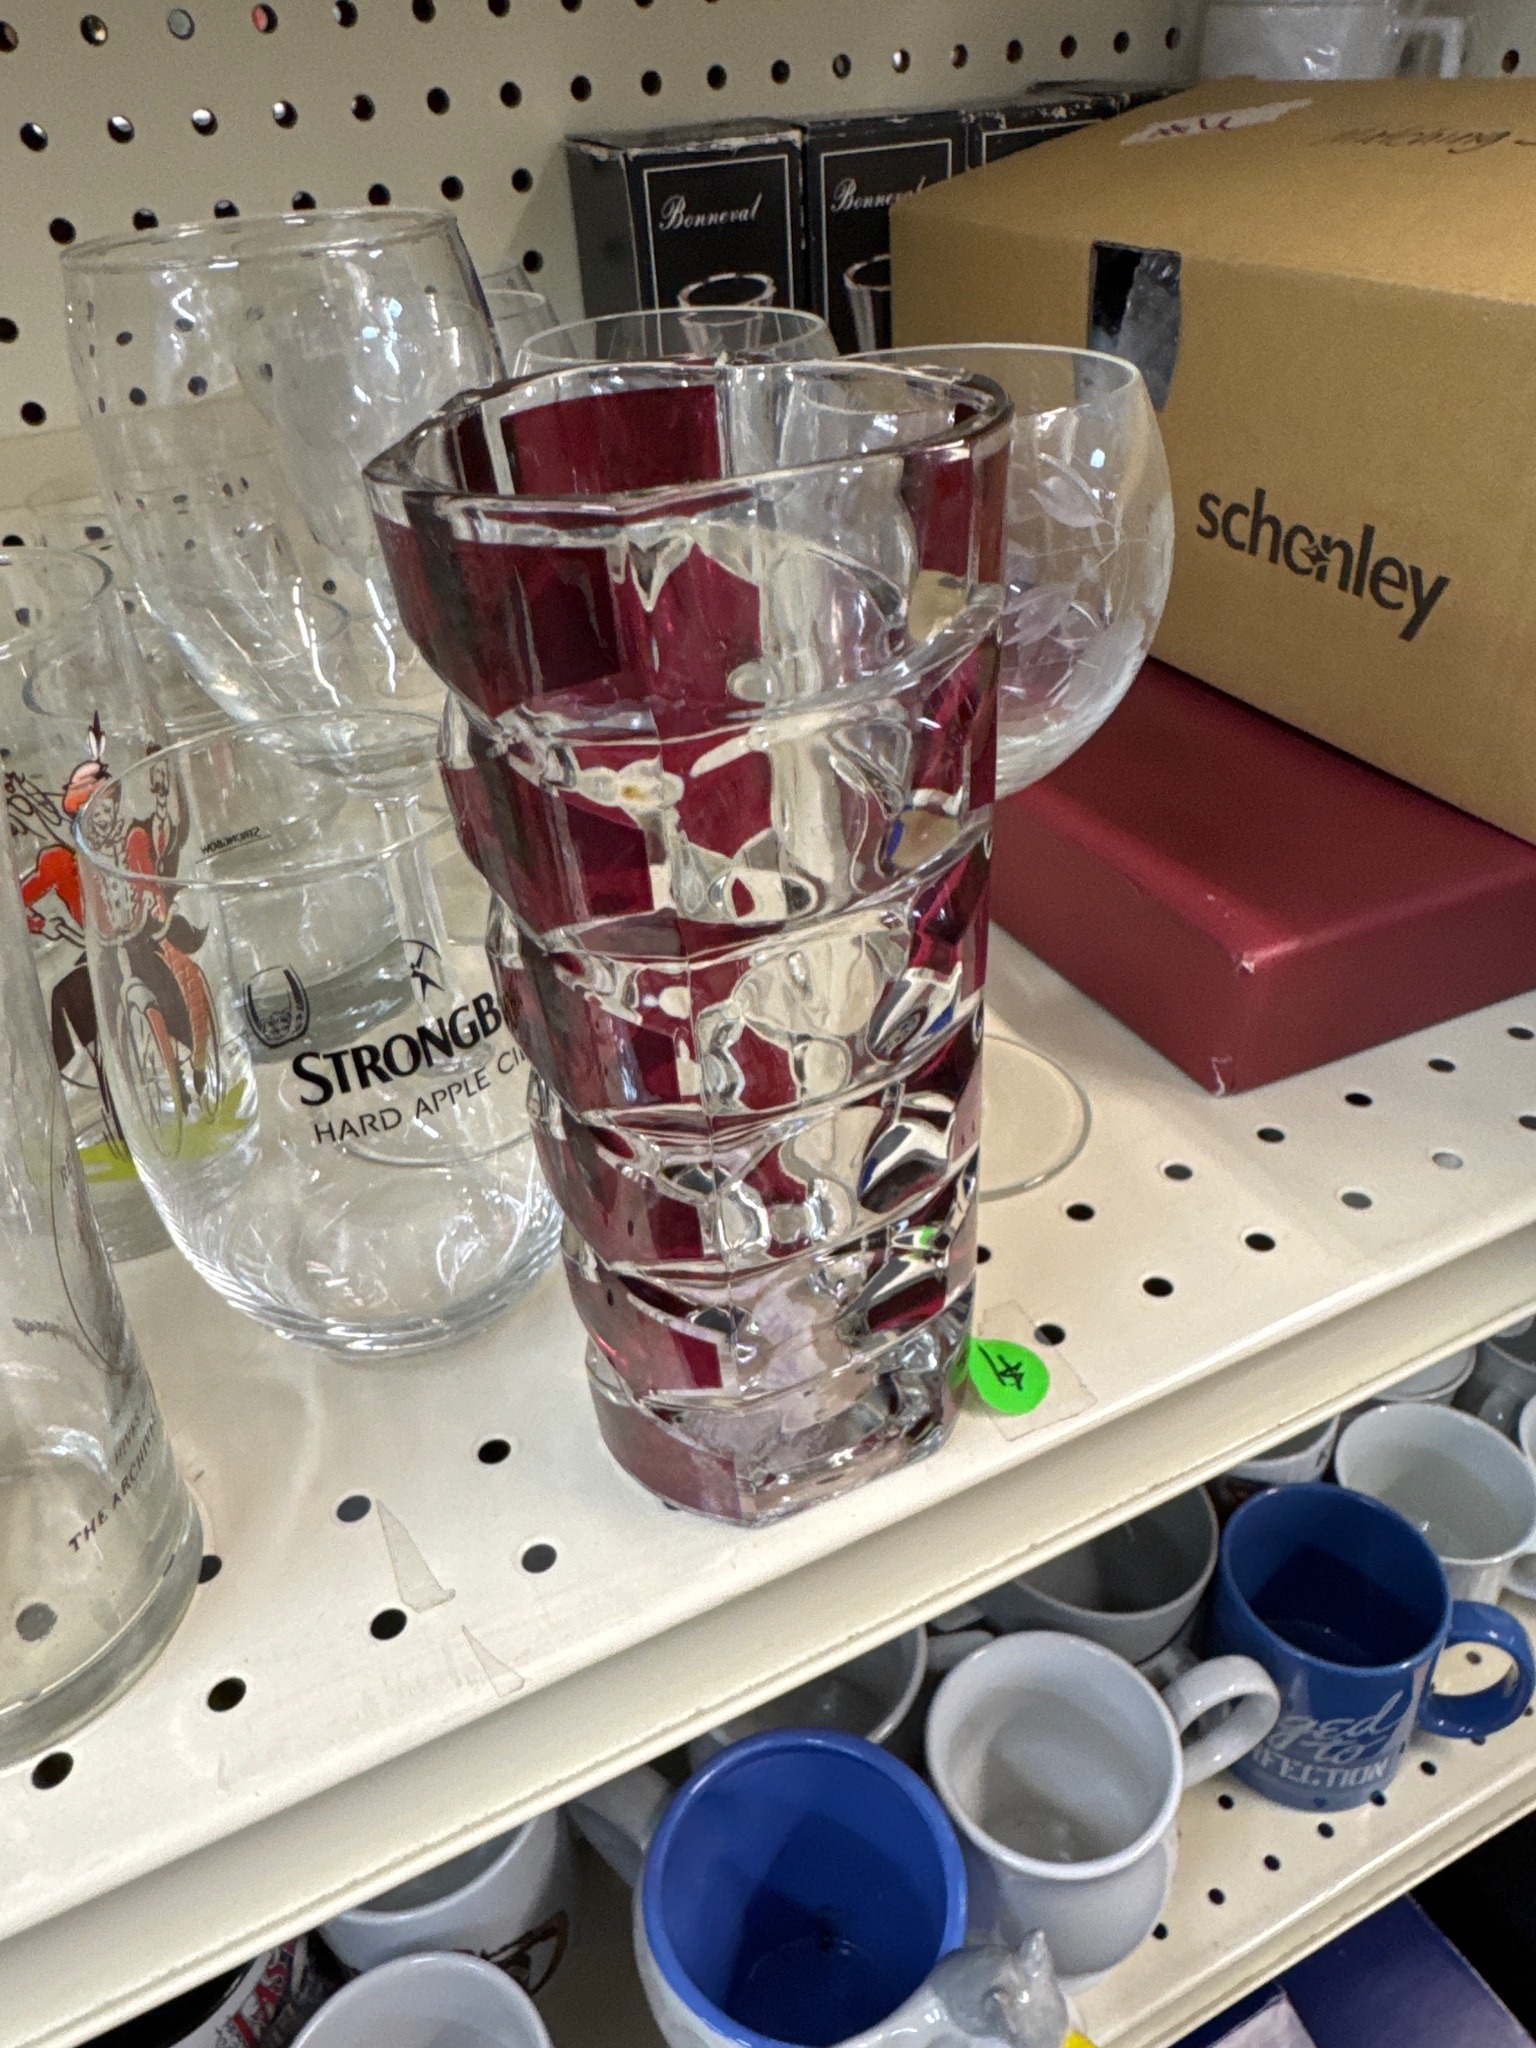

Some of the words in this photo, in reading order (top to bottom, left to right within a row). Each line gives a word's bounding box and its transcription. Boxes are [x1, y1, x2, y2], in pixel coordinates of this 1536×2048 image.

[659, 192, 762, 231] Bonneval
[1196, 487, 1450, 642] schenley
[292, 992, 503, 1107] STRONGB
[314, 1107, 403, 1145] HARD
[416, 1067, 492, 1119] APPLE
[68, 1508, 109, 1553] THE
